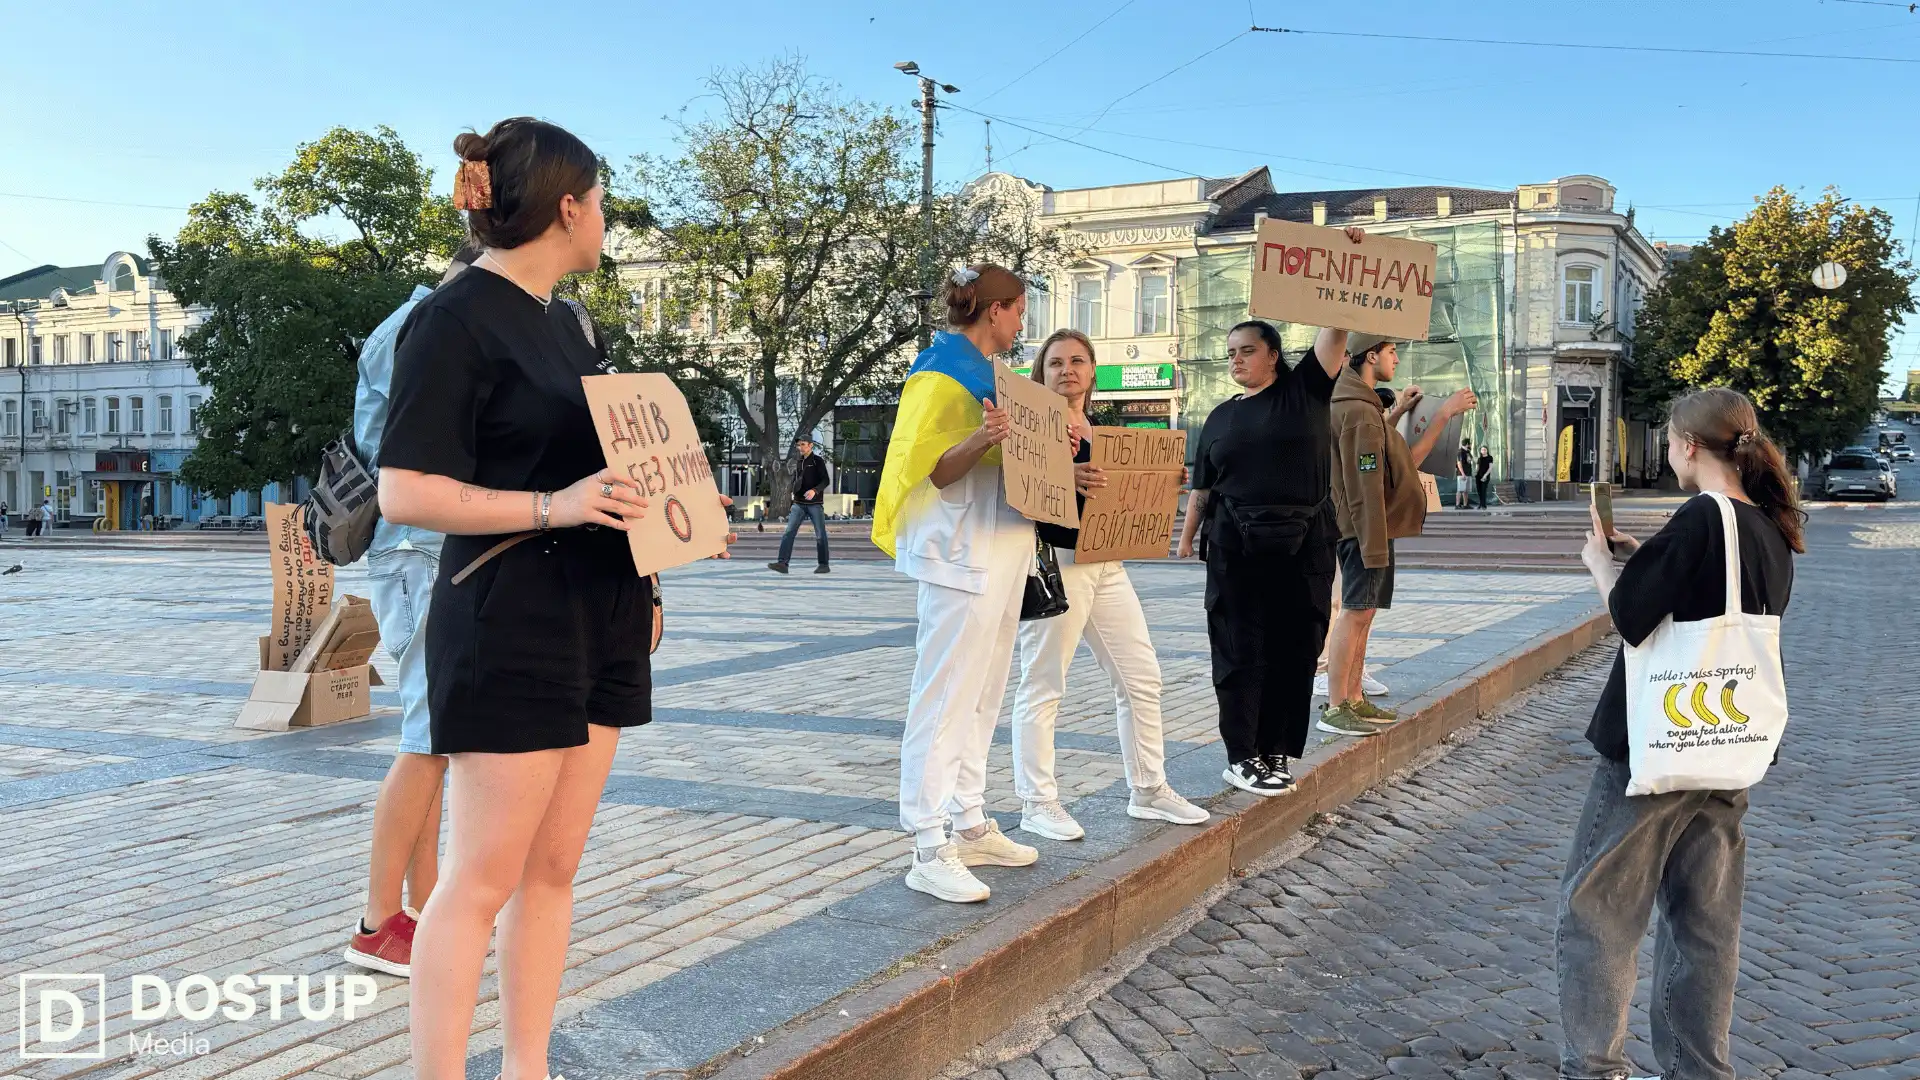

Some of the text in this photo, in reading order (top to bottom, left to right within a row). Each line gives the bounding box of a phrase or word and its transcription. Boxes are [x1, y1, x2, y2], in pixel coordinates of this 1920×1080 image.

[1352, 292, 1369, 307] НЕ
[1372, 296, 1404, 312] ЛОХ
[1098, 432, 1139, 465] ТОБІ
[1118, 472, 1168, 512] ЧУТИ
[1082, 508, 1171, 552] СВІЙ НАРОД
[283, 556, 293, 577] цю
[1684, 667, 1713, 679] Miss
[1714, 663, 1757, 680] Spring!
[330, 681, 359, 692] СТАРОГО
[336, 690, 353, 700] ЛЕВА
[1667, 730, 1679, 738] Do
[1679, 730, 1699, 740] you
[1697, 725, 1717, 739] feel
[1675, 741, 1695, 753] you
[1711, 736, 1726, 746] the
